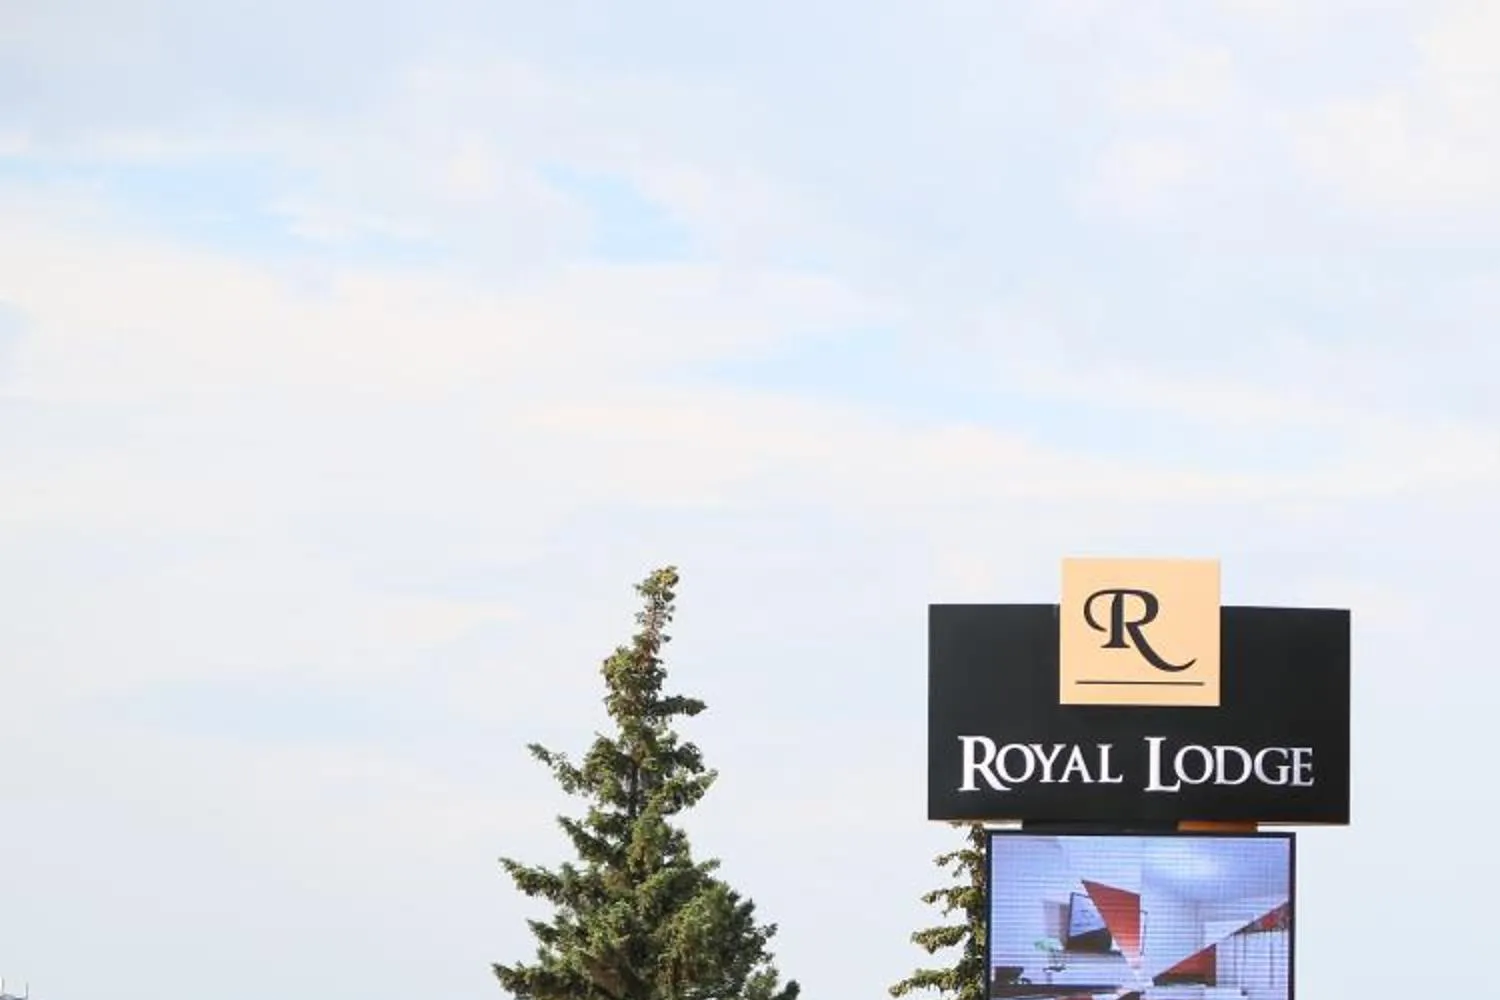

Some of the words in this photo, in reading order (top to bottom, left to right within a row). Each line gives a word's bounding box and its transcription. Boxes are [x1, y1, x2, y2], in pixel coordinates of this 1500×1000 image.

[1084, 588, 1197, 672] R
[957, 735, 1123, 792] ROYAL
[1143, 736, 1314, 792] LODGE
